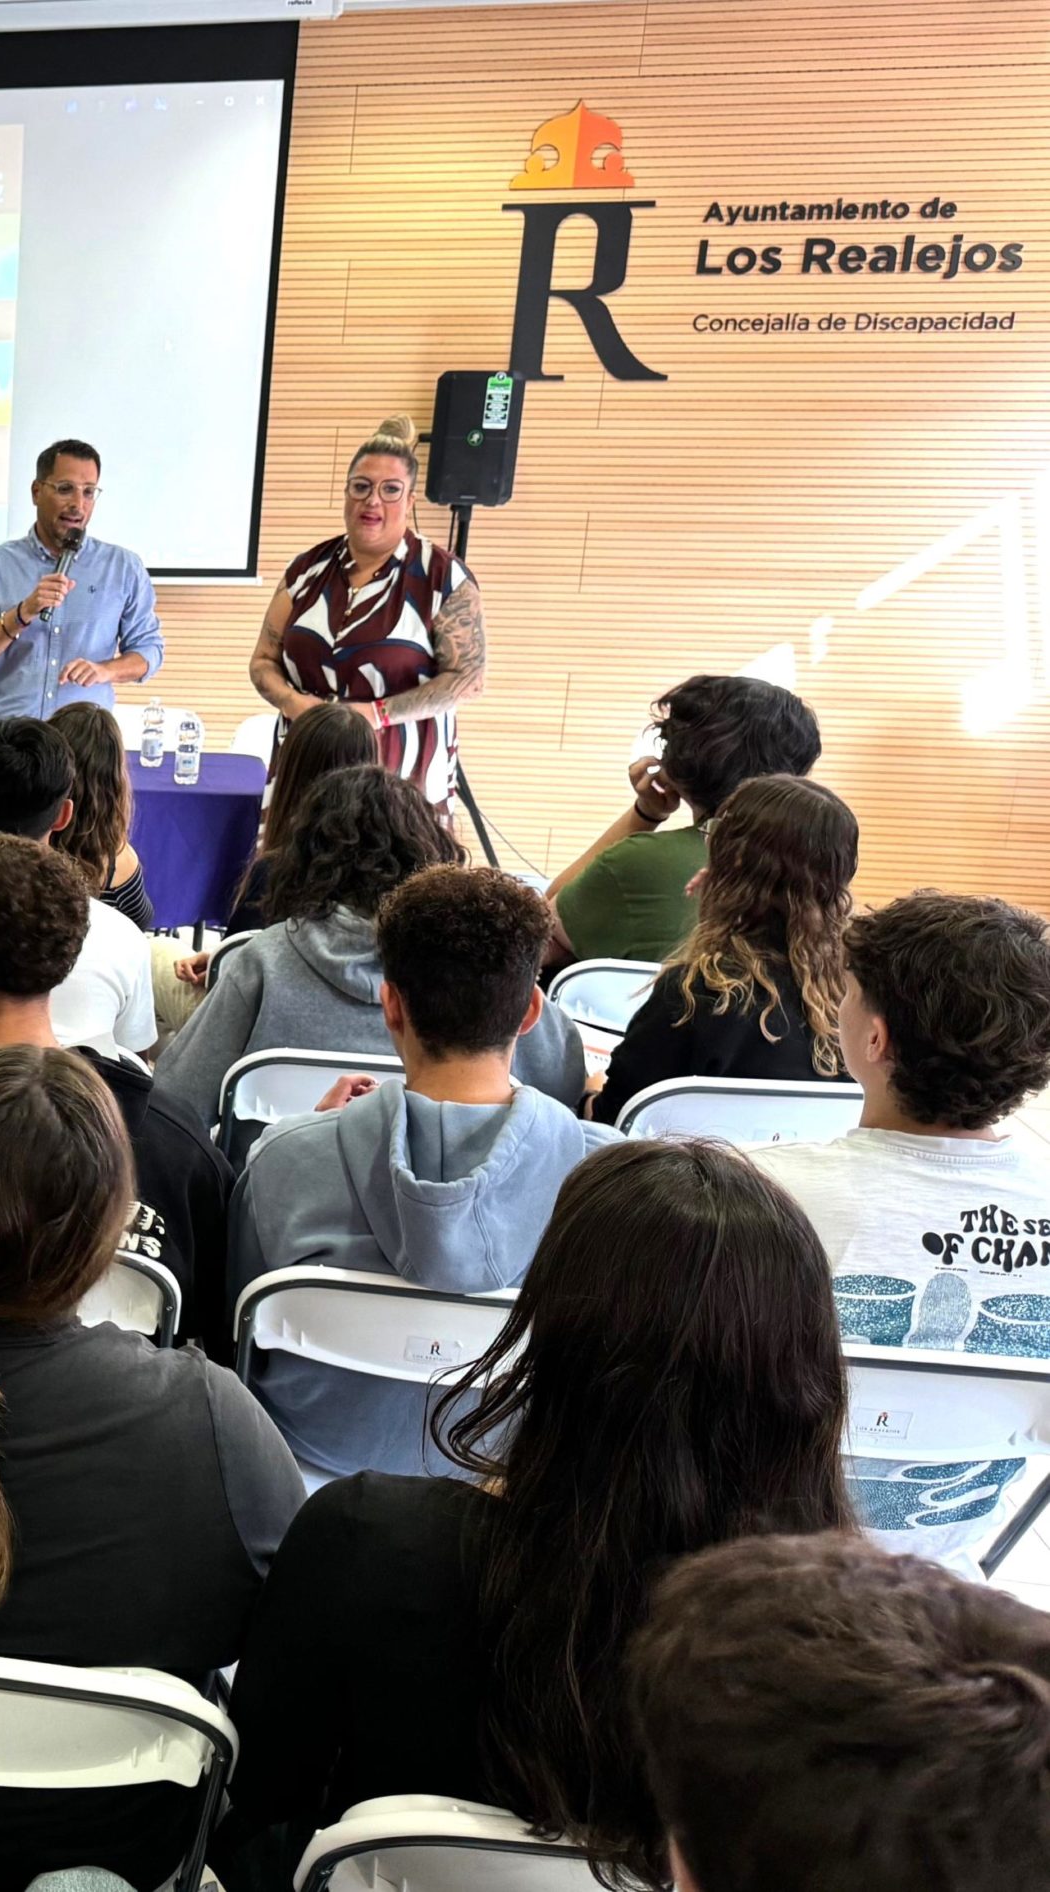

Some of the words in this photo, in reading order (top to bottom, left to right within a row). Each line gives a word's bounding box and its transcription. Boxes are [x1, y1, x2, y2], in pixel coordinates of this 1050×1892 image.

[703, 199, 911, 224] Ayuntamiento
[919, 197, 958, 220] de
[695, 239, 783, 277] Los
[801, 235, 1025, 280] Realejos
[692, 312, 811, 335] Concejalía
[817, 312, 847, 331] de
[854, 311, 1015, 334] Discapacidad
[960, 1204, 1019, 1236] THE
[922, 1231, 965, 1265] OF
